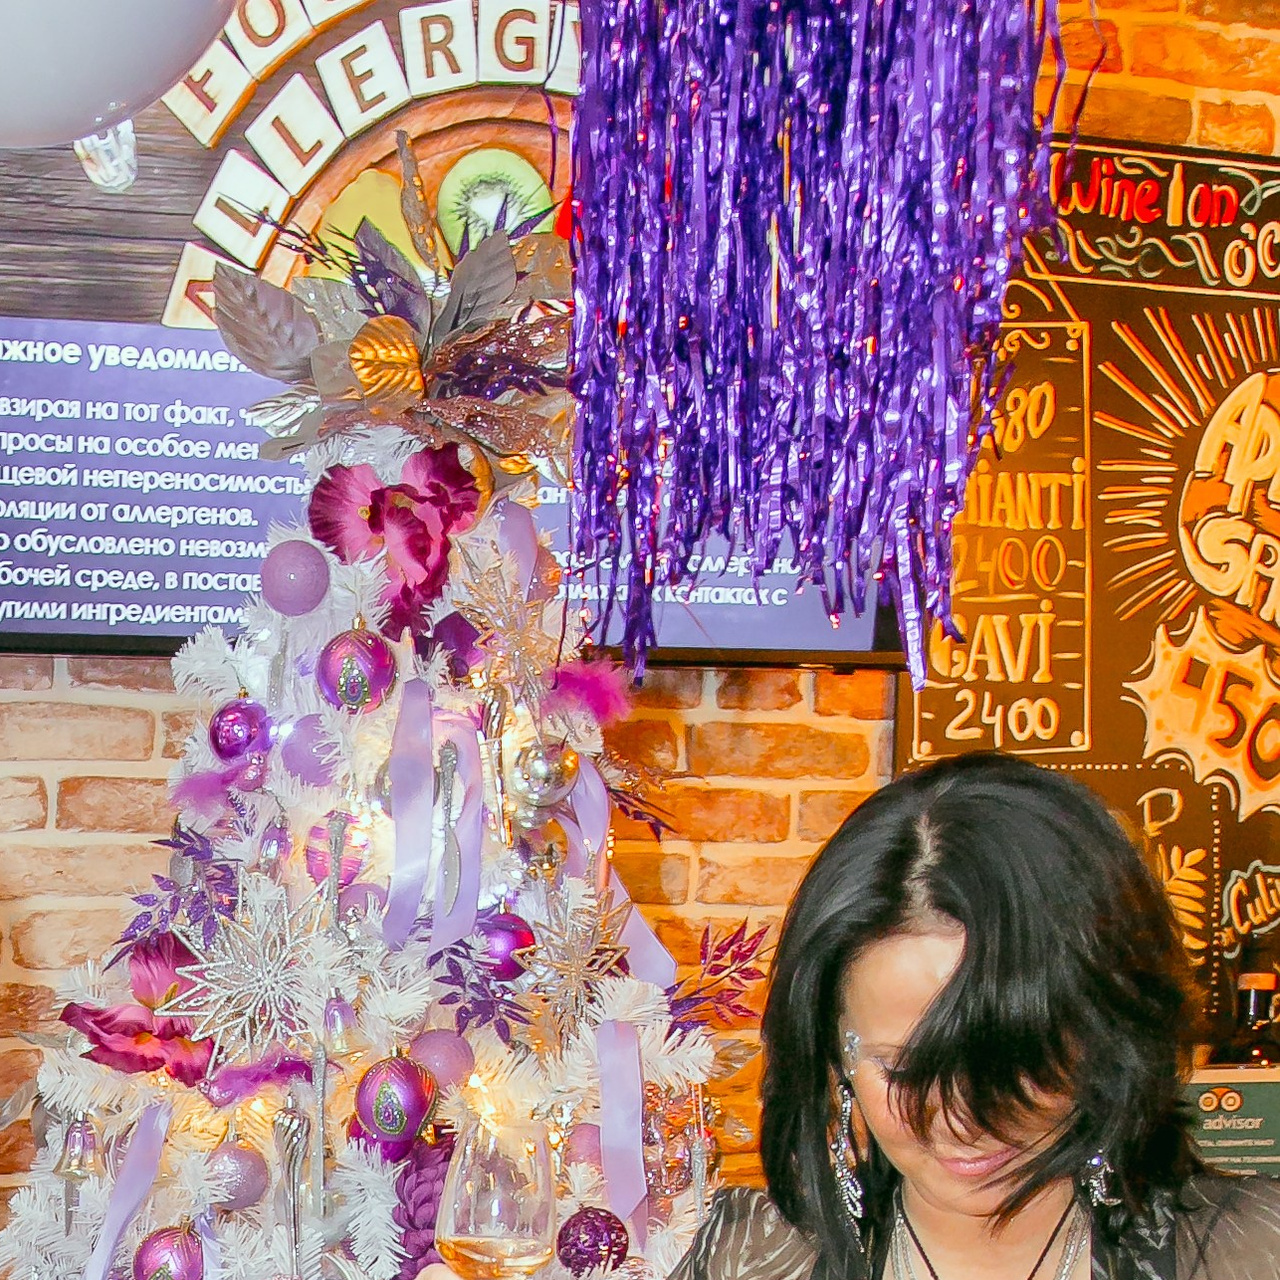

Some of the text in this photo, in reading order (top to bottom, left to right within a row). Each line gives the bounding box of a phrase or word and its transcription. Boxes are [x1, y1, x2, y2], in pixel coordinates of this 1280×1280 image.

[184, 8, 581, 328] ALLERG
[1050, 153, 1162, 224] Wine
[86, 401, 119, 422] на
[123, 402, 160, 423] тот
[164, 399, 235, 428] факт,
[78, 434, 110, 456] на
[114, 432, 210, 460] особое
[80, 503, 109, 522] от
[112, 504, 260, 528] аллергенов.
[13, 528, 175, 557] обусловлено
[74, 568, 160, 592] среде,
[164, 572, 178, 590] в
[945, 688, 1061, 748] 2400
